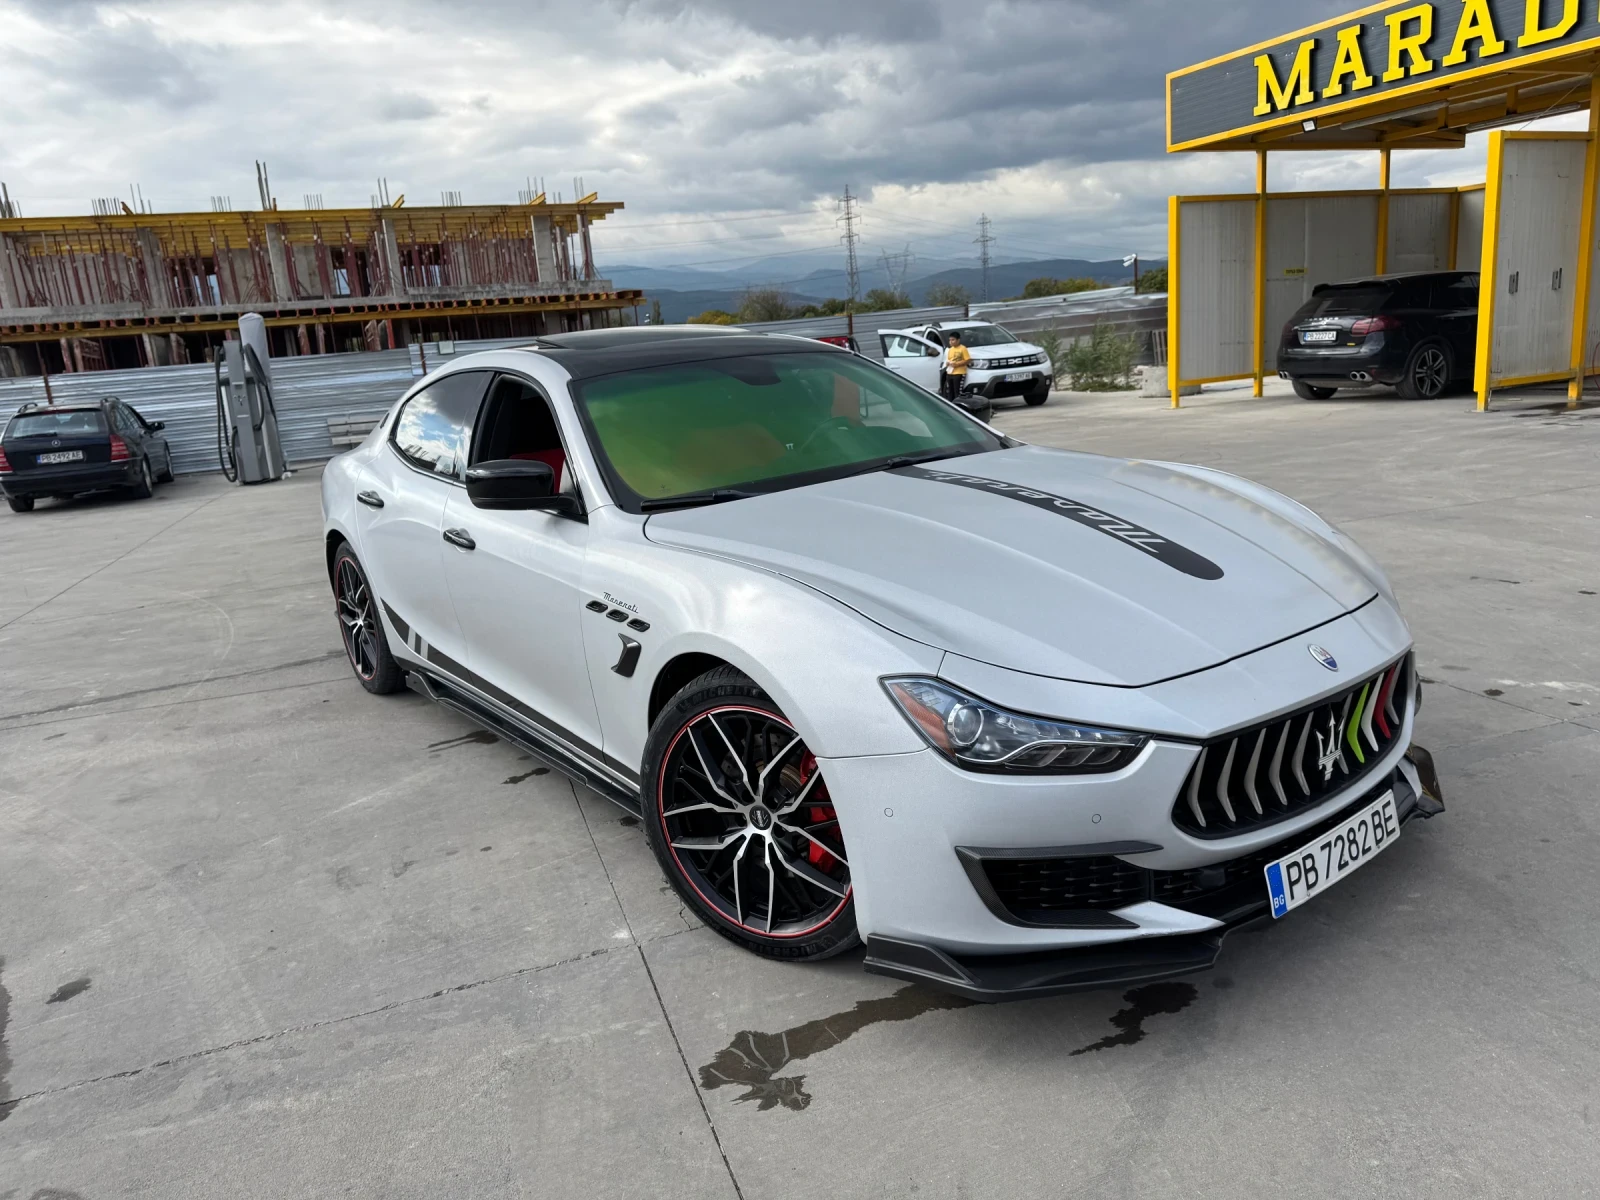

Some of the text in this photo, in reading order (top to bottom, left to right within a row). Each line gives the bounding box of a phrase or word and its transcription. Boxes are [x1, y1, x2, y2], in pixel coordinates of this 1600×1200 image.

[1253, 0, 1600, 116] MARAD
[41, 454, 51, 462] PB
[52, 452, 70, 461] 2492
[928, 471, 1167, 553] Maserati
[603, 591, 639, 614] Maserati
[1274, 800, 1396, 909] BG PB 7282 BE
